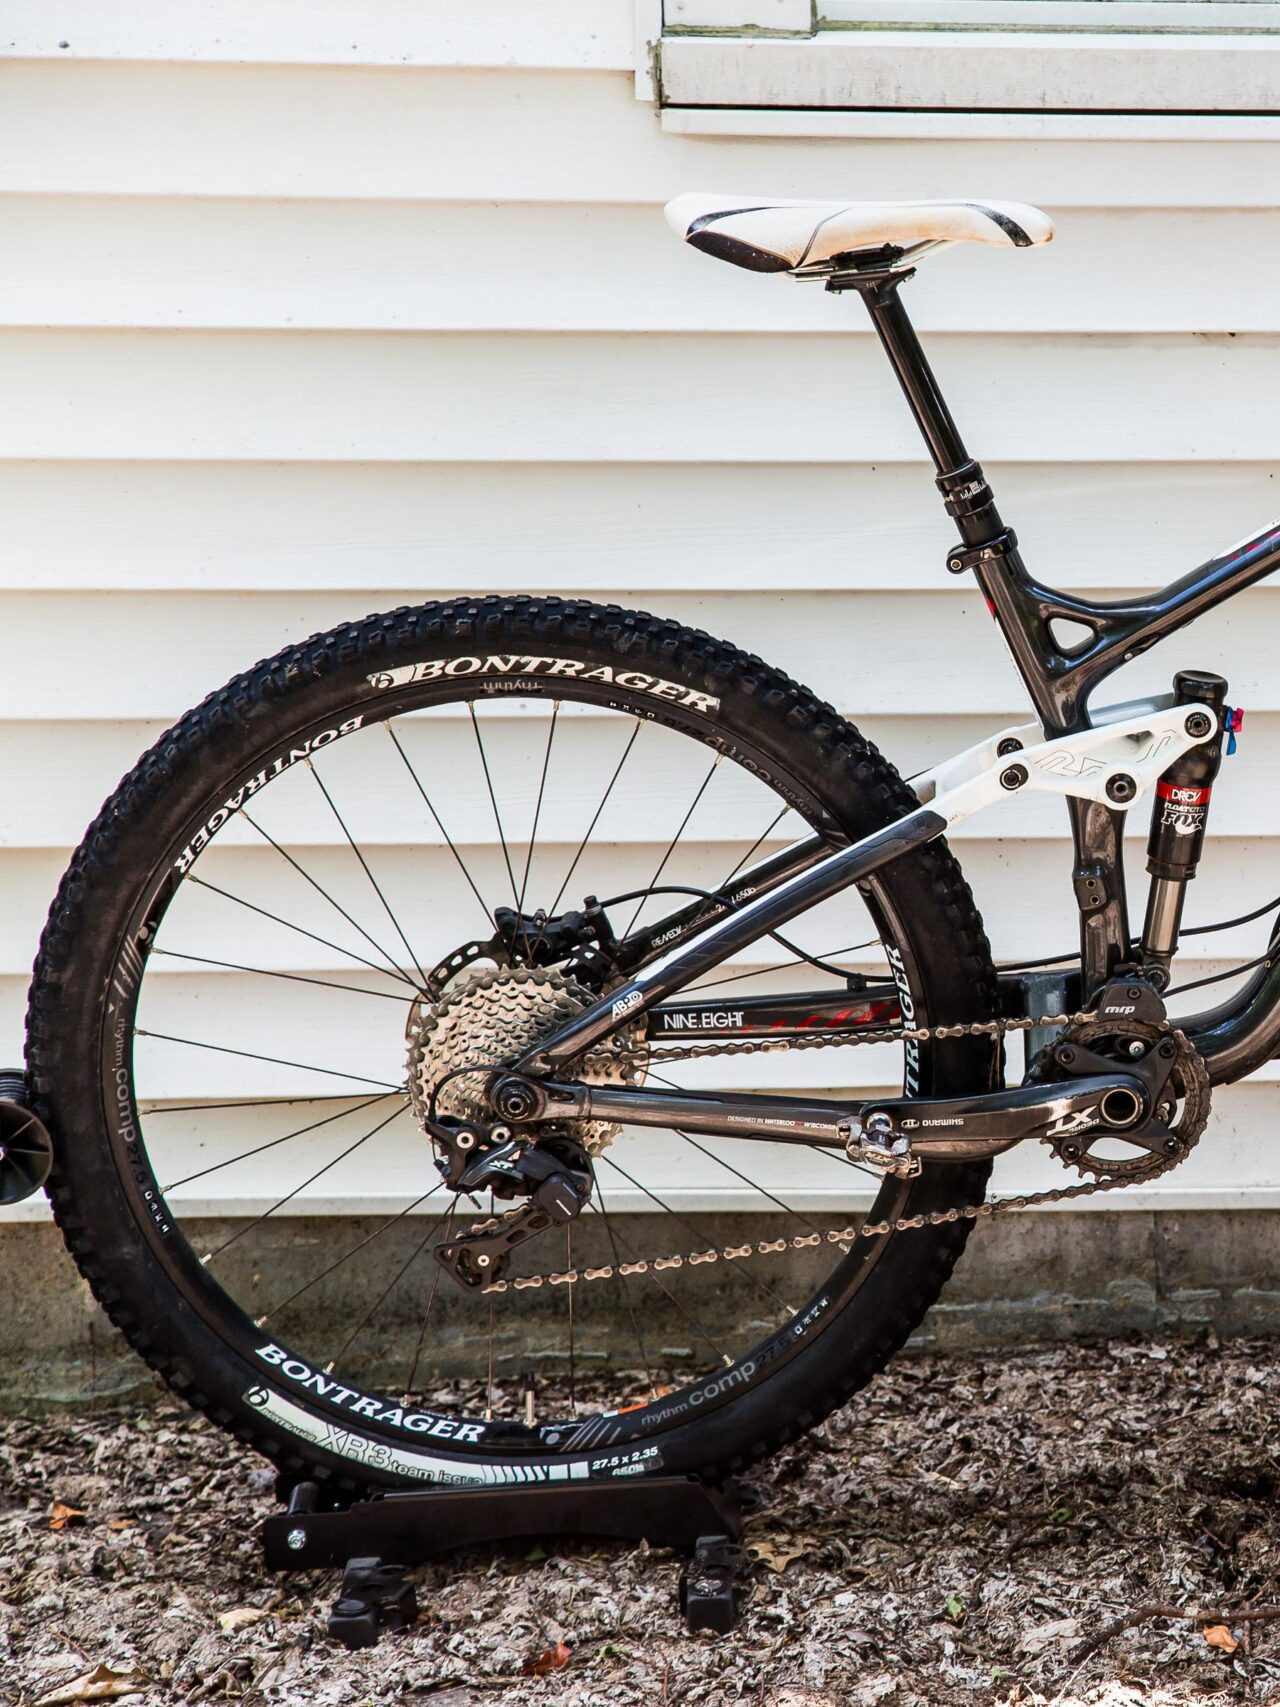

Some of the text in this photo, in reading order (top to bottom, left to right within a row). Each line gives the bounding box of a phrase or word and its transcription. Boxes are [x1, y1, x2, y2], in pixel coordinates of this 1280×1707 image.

[411, 655, 720, 713] BONTRAGER
[174, 715, 364, 873] BONTRAGER
[1161, 809, 1205, 834] FOX
[664, 1012, 744, 1029] NINE.EIGHT
[1105, 1005, 1135, 1014] mrp
[113, 1018, 127, 1067] rhythm
[115, 1068, 136, 1142] comp
[727, 1116, 756, 1124] DESIGNED
[764, 1118, 796, 1127] WATERLOO
[922, 1117, 964, 1127] SHIMANO
[1046, 1105, 1098, 1136] XT
[255, 1343, 486, 1442] BONTRAGER
[641, 1402, 688, 1426] rhythm
[689, 1361, 756, 1406] comp
[317, 1423, 393, 1470] XR3
[391, 1459, 435, 1481] team
[592, 1446, 659, 1470] 27.5 x 2.35
